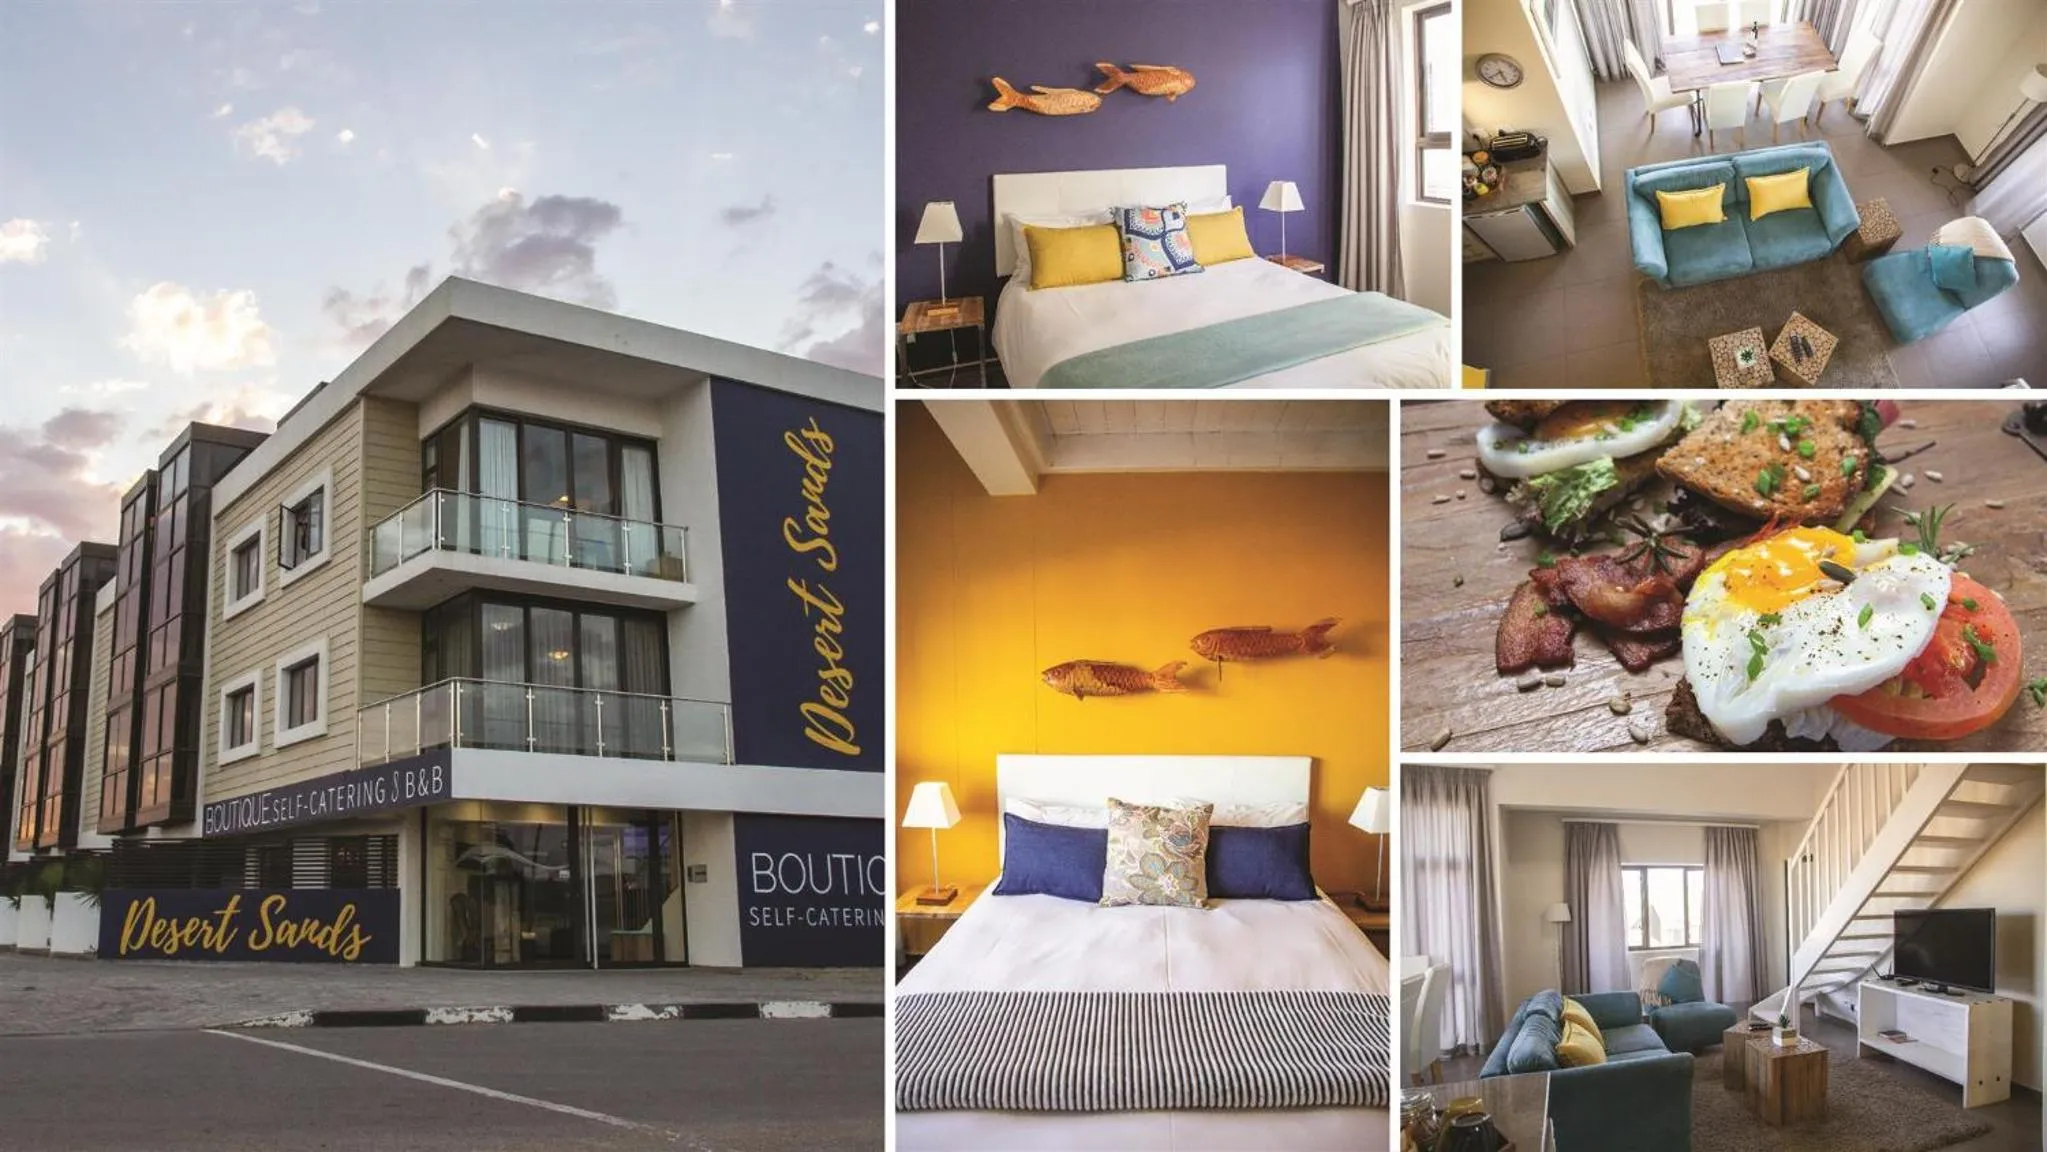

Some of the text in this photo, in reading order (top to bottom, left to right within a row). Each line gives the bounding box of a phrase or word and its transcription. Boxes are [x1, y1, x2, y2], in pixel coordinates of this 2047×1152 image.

[783, 415, 863, 757] Desert Sands
[205, 792, 273, 835] BOUTIQUE
[272, 776, 387, 823] SELF-CATERING
[404, 764, 444, 799] B&B
[119, 894, 372, 962] Desert Sands
